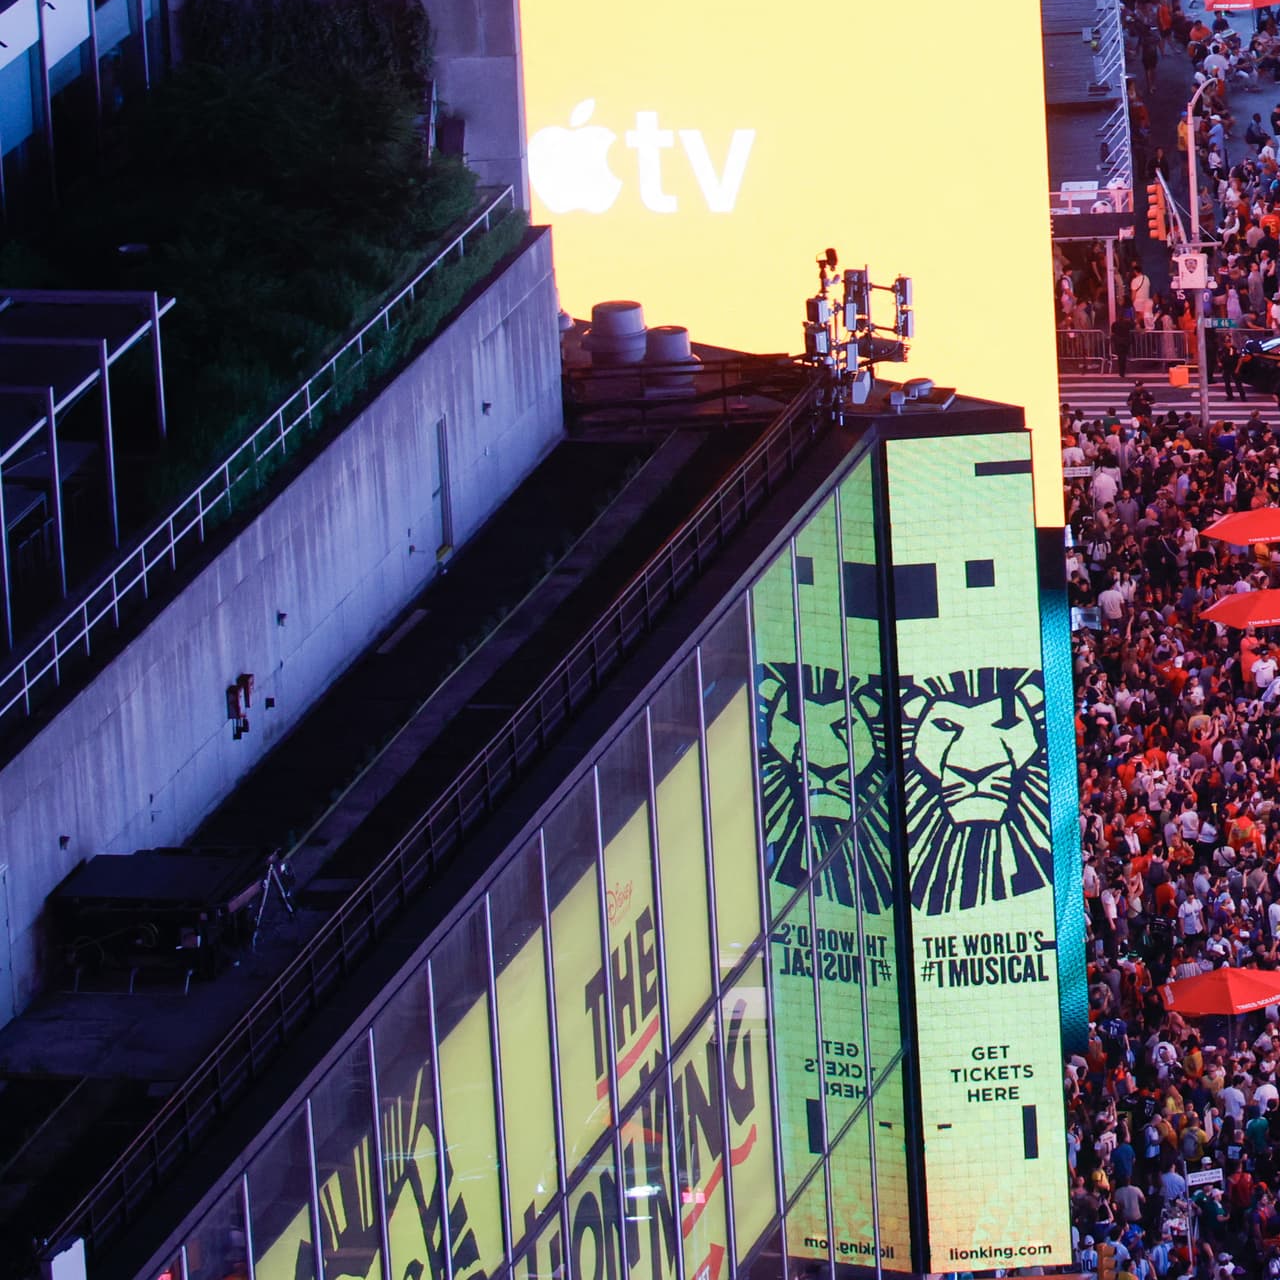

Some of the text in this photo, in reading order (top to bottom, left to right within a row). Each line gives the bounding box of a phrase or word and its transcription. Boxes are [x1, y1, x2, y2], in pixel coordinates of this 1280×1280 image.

[624, 111, 756, 213] tv
[922, 930, 1044, 959] THE WORLD'S
[948, 953, 1049, 987] MUSICAL
[584, 905, 658, 1081] THE
[971, 1045, 1010, 1061] GET
[950, 1064, 1035, 1083] TICKETS
[967, 1086, 1021, 1103] HERE
[949, 1243, 1053, 1261] lionking.com
